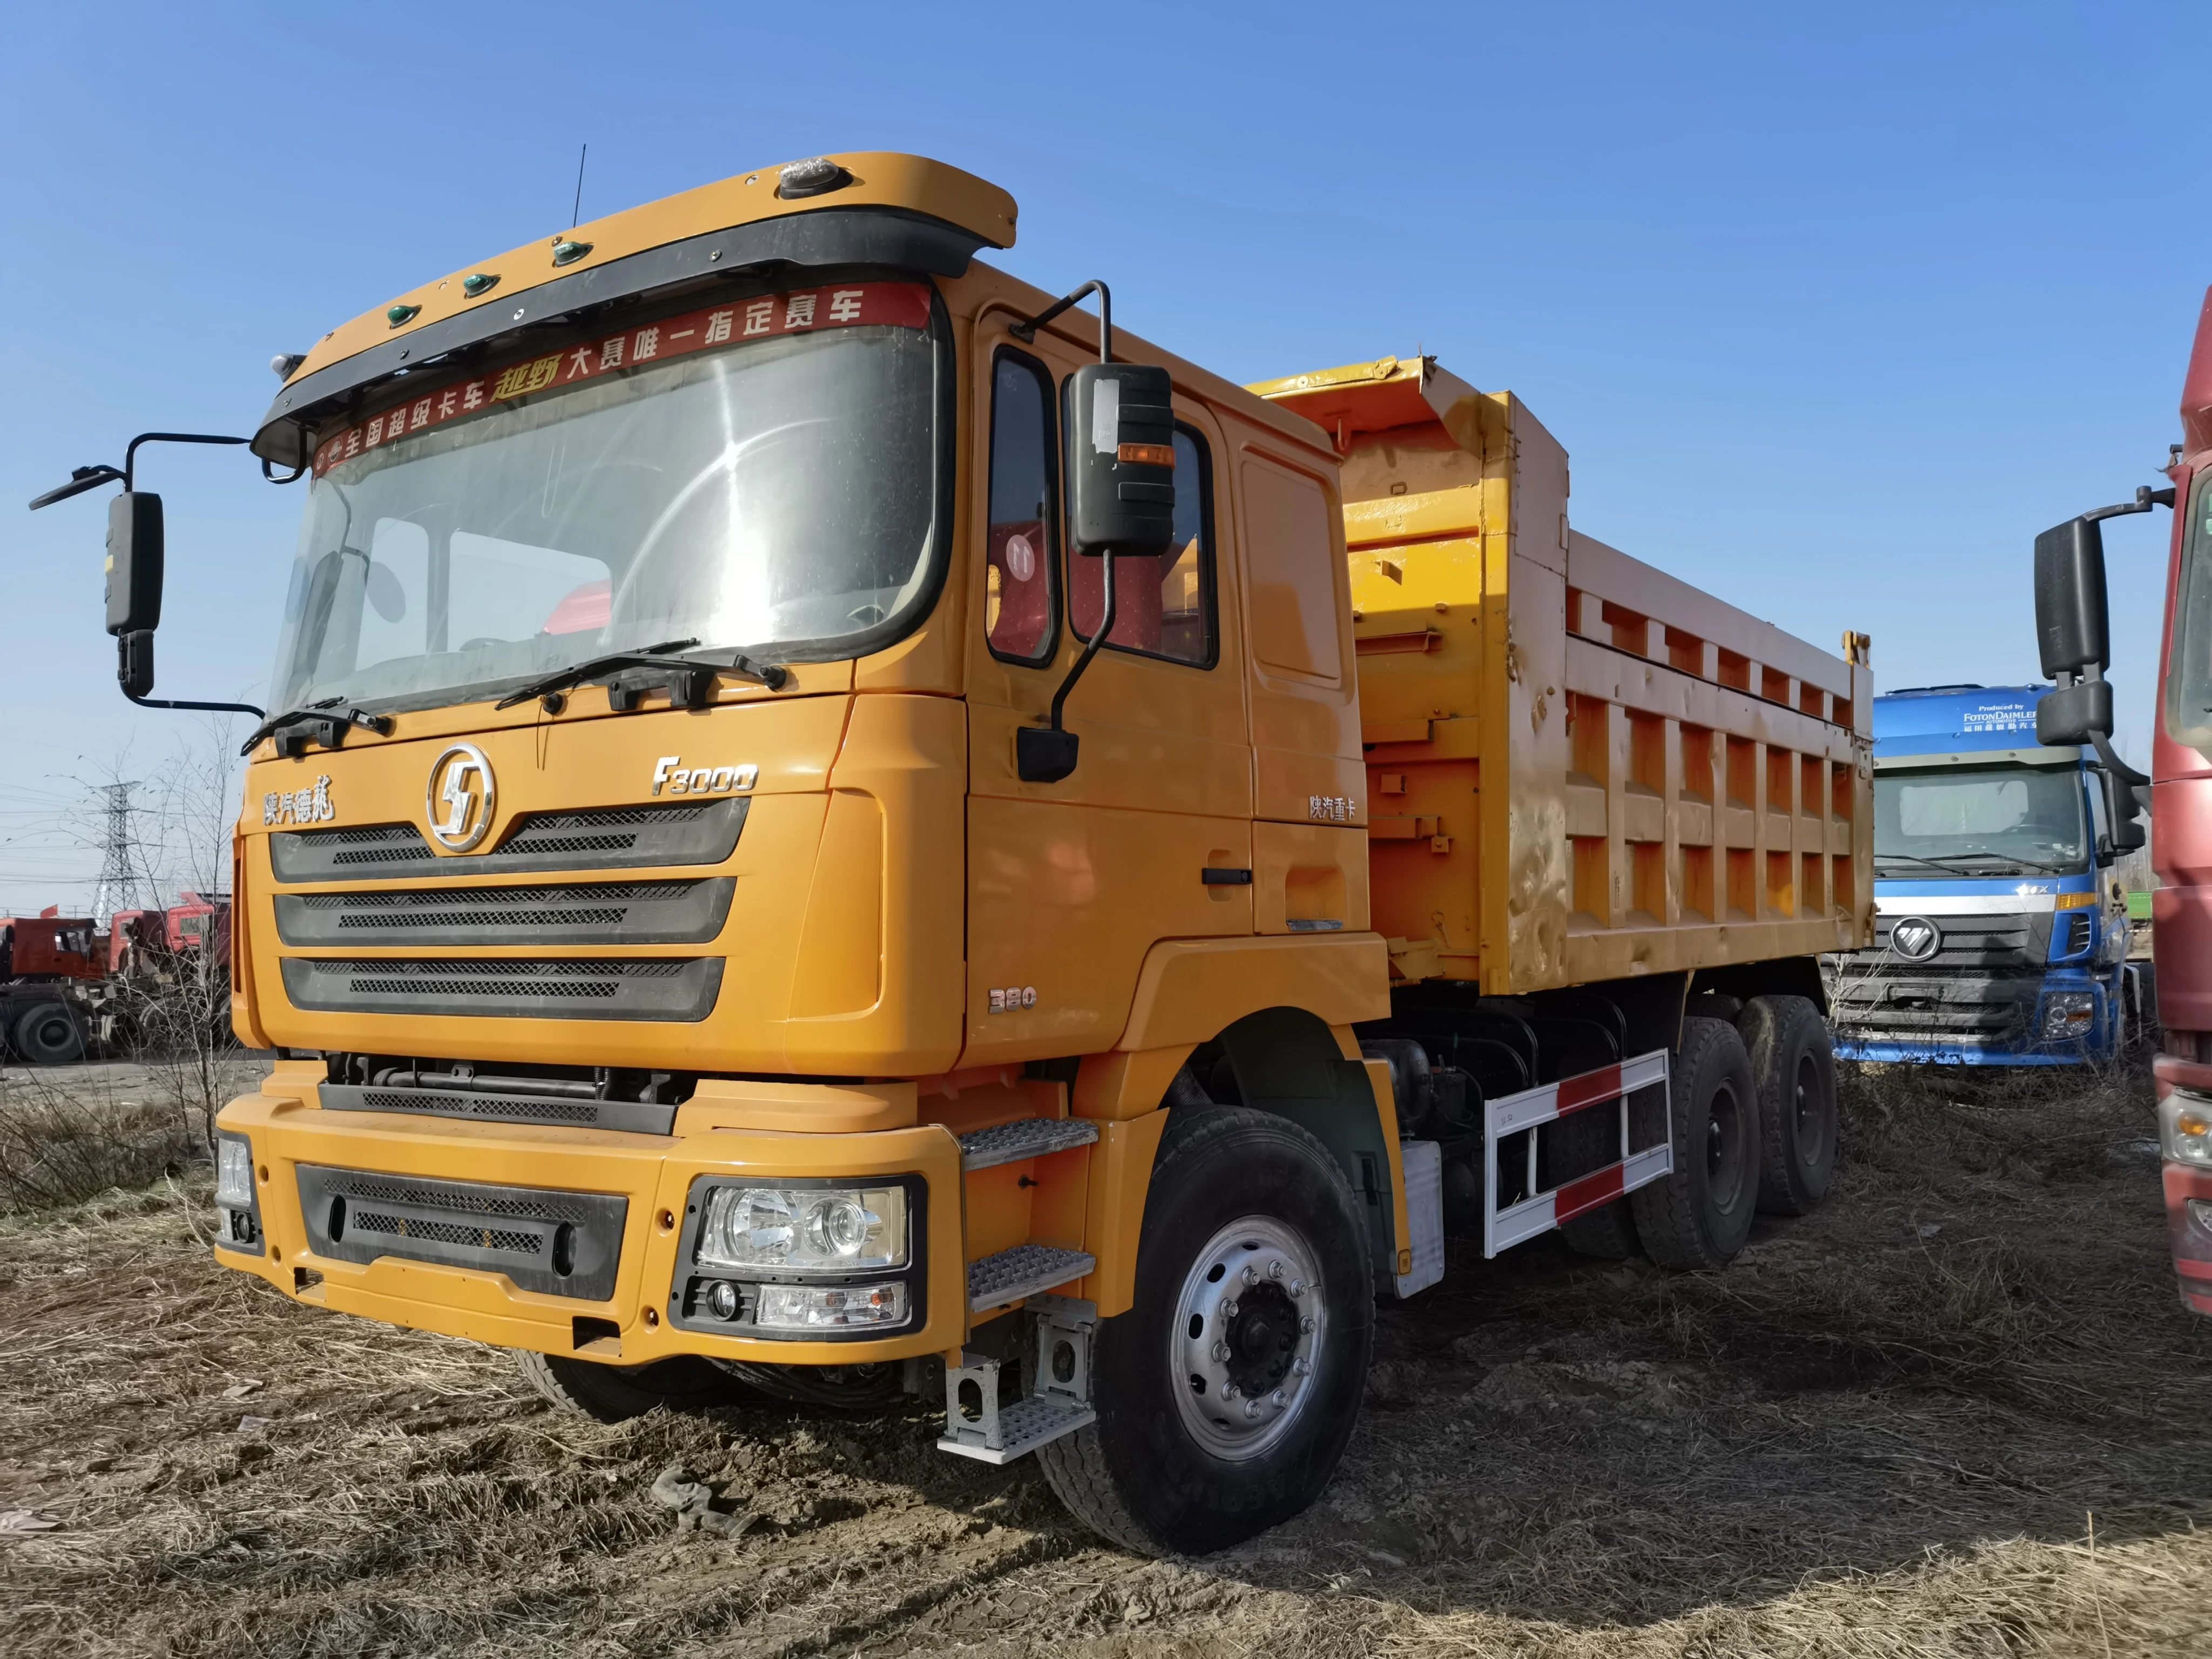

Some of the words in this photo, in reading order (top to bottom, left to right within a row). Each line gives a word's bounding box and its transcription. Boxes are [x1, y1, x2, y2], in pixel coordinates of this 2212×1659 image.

[651, 756, 759, 796] F3000
[1309, 794, 1355, 821] 陕汽重卡
[988, 986, 1037, 1014] 380
